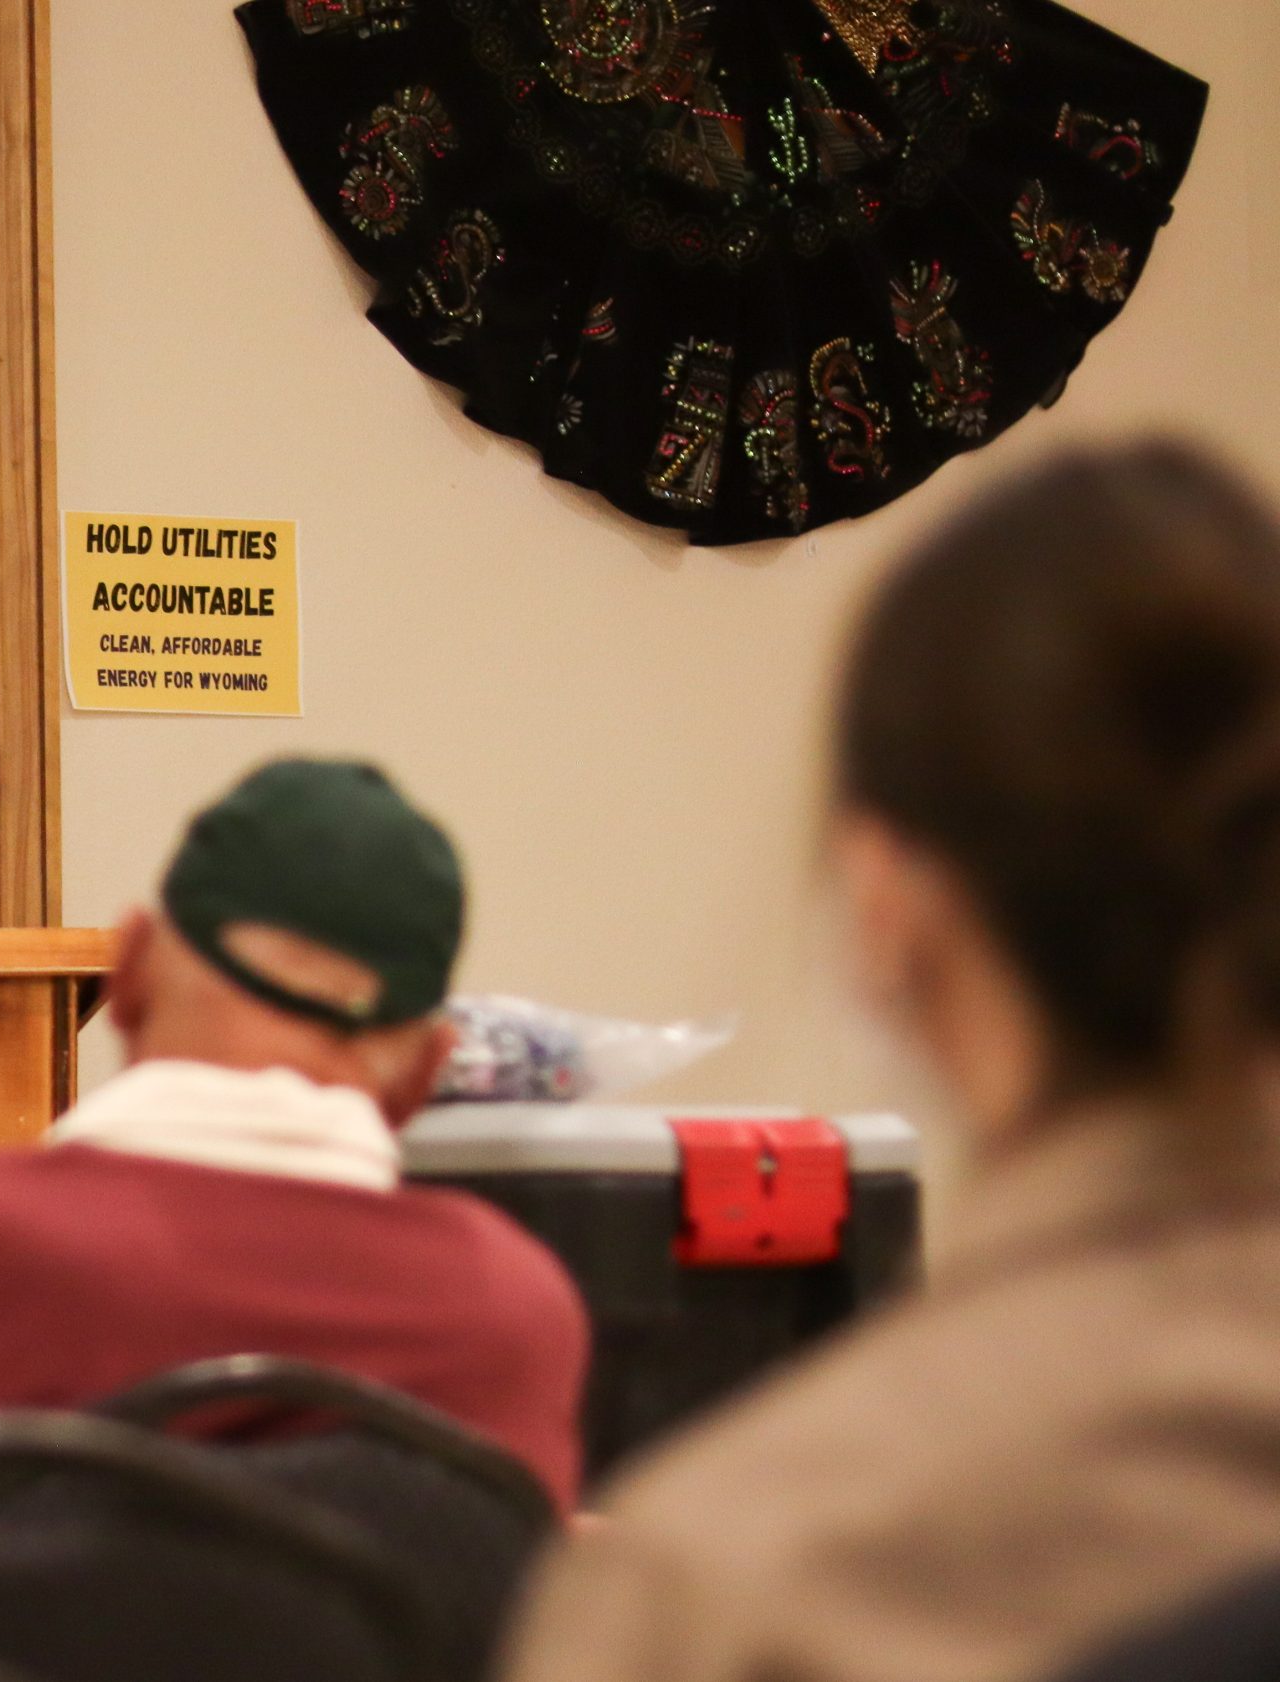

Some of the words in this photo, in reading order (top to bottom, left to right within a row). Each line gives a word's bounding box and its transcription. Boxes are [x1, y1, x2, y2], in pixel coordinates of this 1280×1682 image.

[86, 523, 153, 555] HOLD
[162, 527, 277, 560] UTILITIES
[92, 582, 275, 616] ACCOUNTABLE
[100, 634, 155, 655] CLEAN,
[161, 636, 262, 657] AFFORDABLE
[97, 669, 157, 688] ENERGY
[164, 671, 193, 689] FOR
[199, 672, 268, 692] WYOMING
